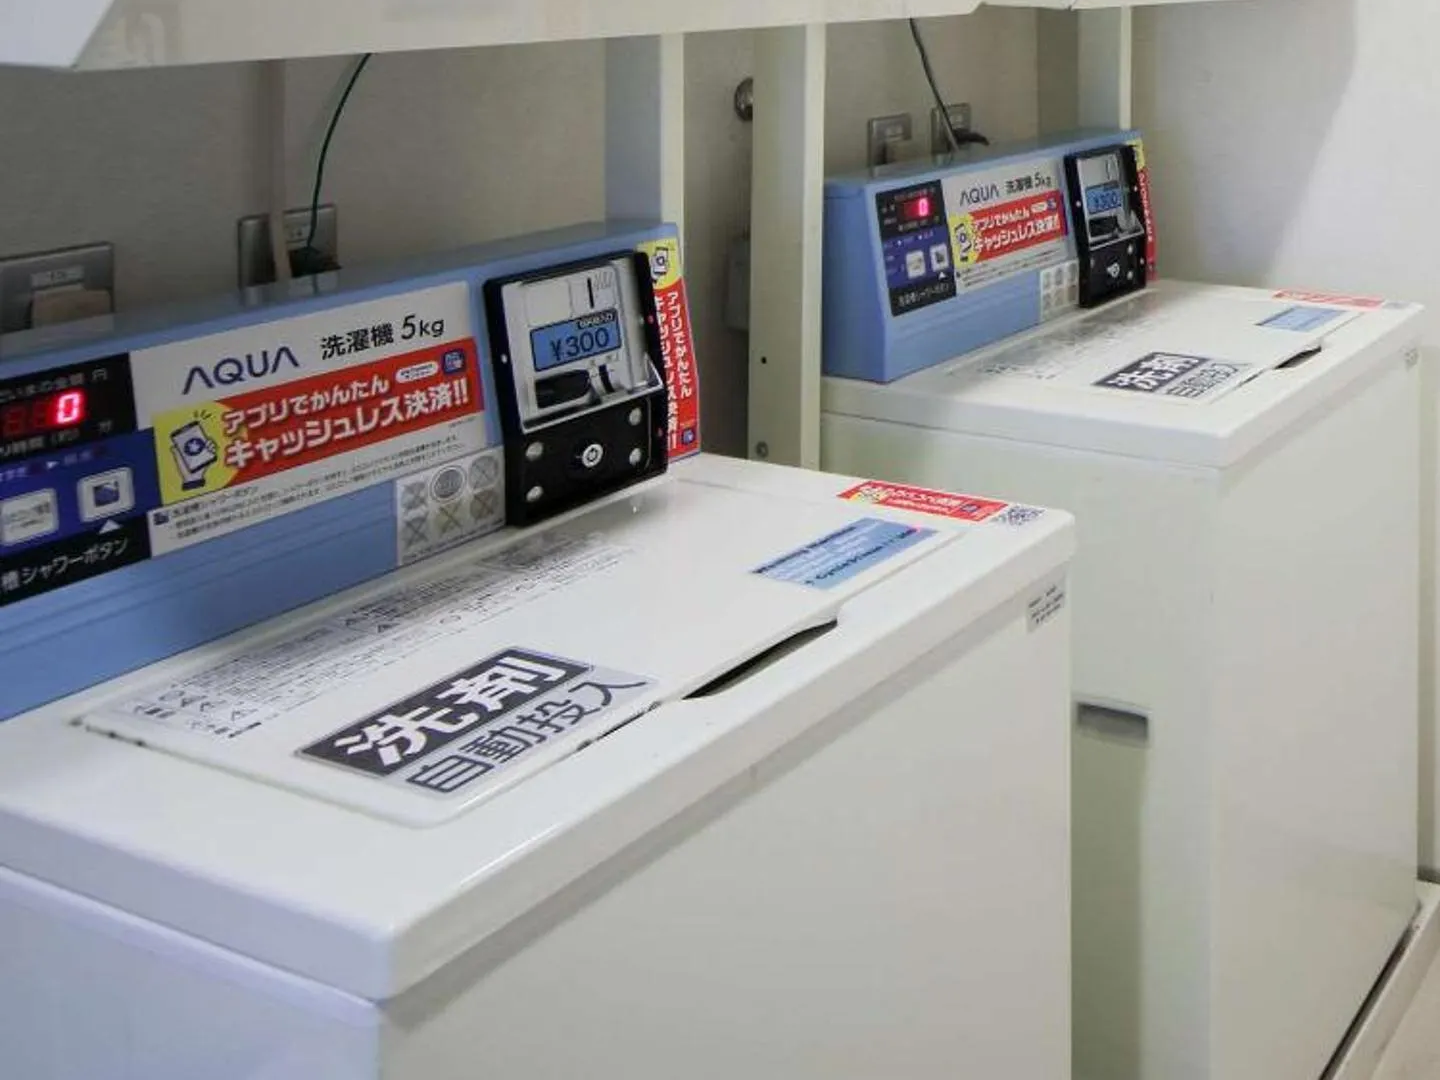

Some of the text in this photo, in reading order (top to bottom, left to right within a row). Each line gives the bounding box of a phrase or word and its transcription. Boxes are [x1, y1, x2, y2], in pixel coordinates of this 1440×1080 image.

[917, 198, 929, 216] 0
[959, 183, 999, 207] AQUA
[972, 207, 1030, 231] アプリでかんたん
[182, 314, 445, 396] AQUA 洗濯機 5kg
[550, 327, 610, 361] ¥300
[56, 391, 84, 425] 0
[224, 373, 390, 435] アプリでかんたん
[224, 379, 469, 469] キャッシュレス決済!!
[334, 655, 571, 767] 洗剤
[405, 678, 648, 793] 自動投入
